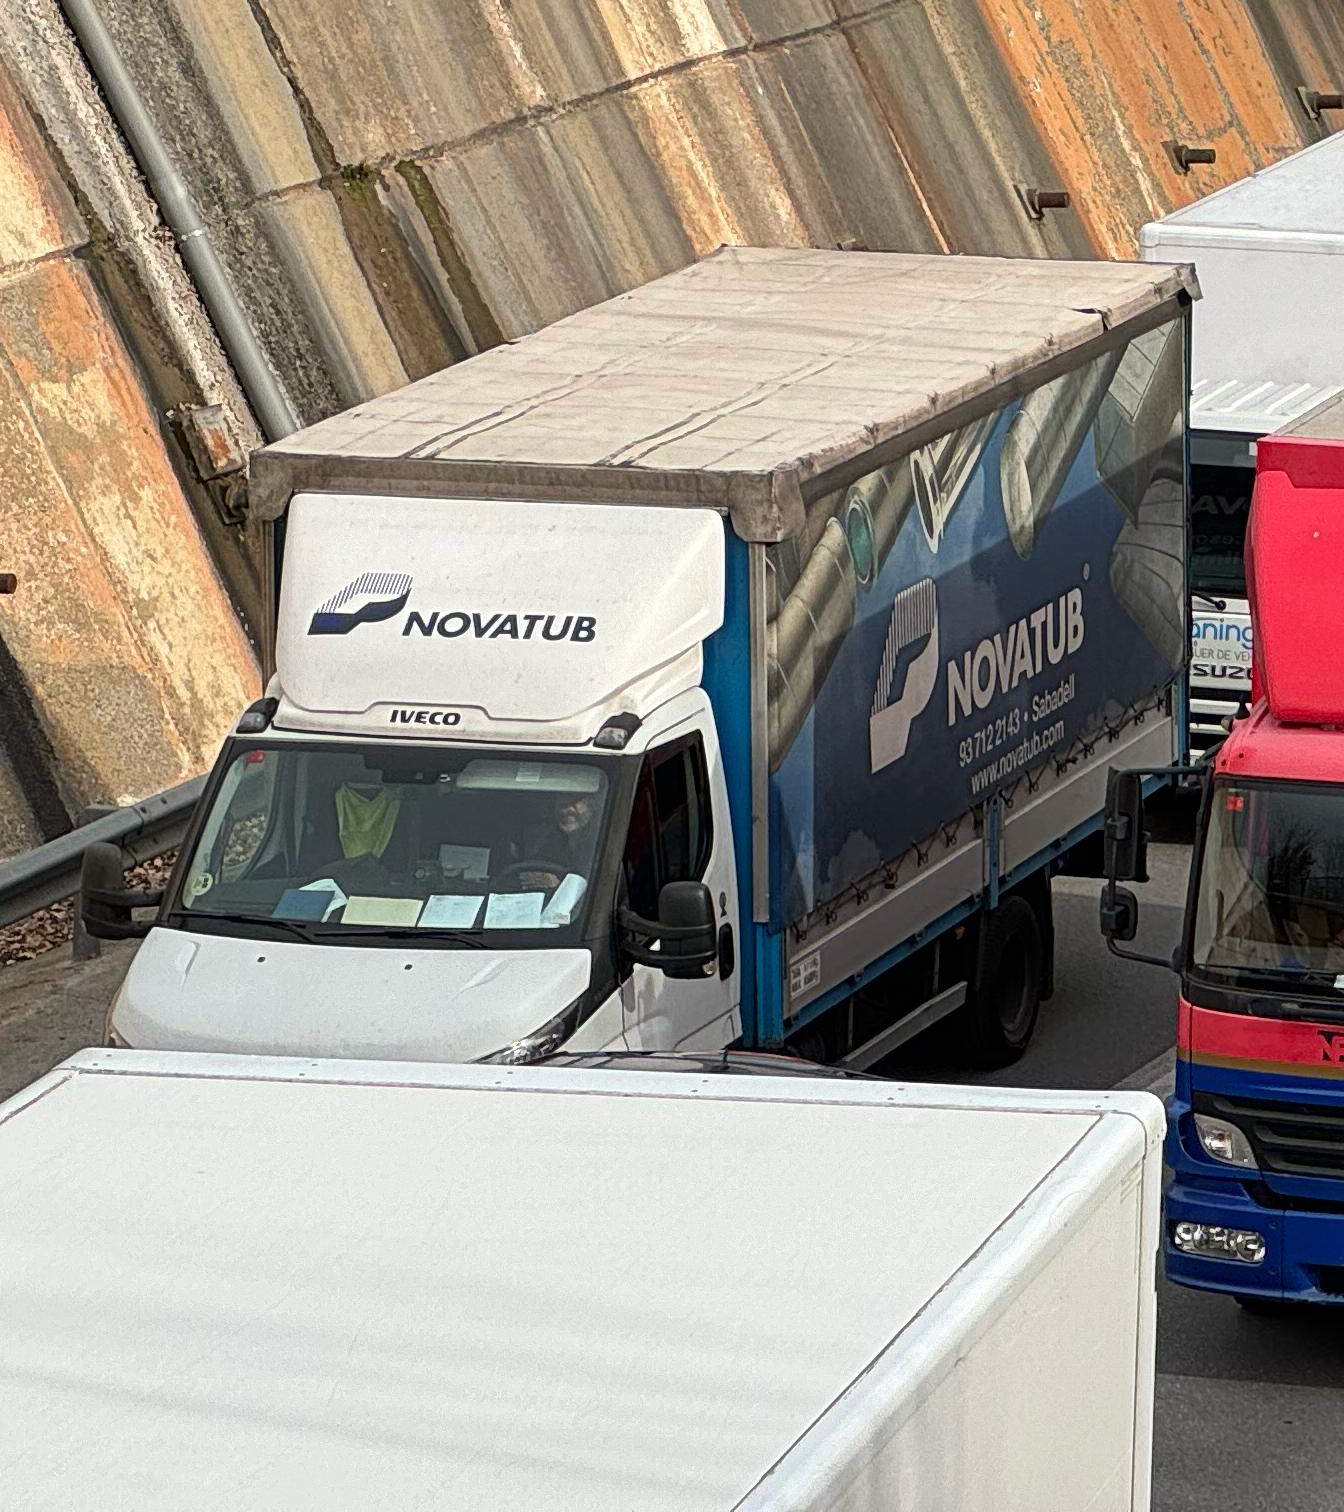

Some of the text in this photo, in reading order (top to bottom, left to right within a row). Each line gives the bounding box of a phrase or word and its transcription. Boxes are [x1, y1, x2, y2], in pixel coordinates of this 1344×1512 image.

[402, 610, 597, 642] NOVATUB
[948, 587, 1085, 727] NOVATUB
[389, 709, 461, 726] IVECO
[1032, 672, 1075, 722] Sabadell
[971, 720, 1065, 795] www.novatub.com
